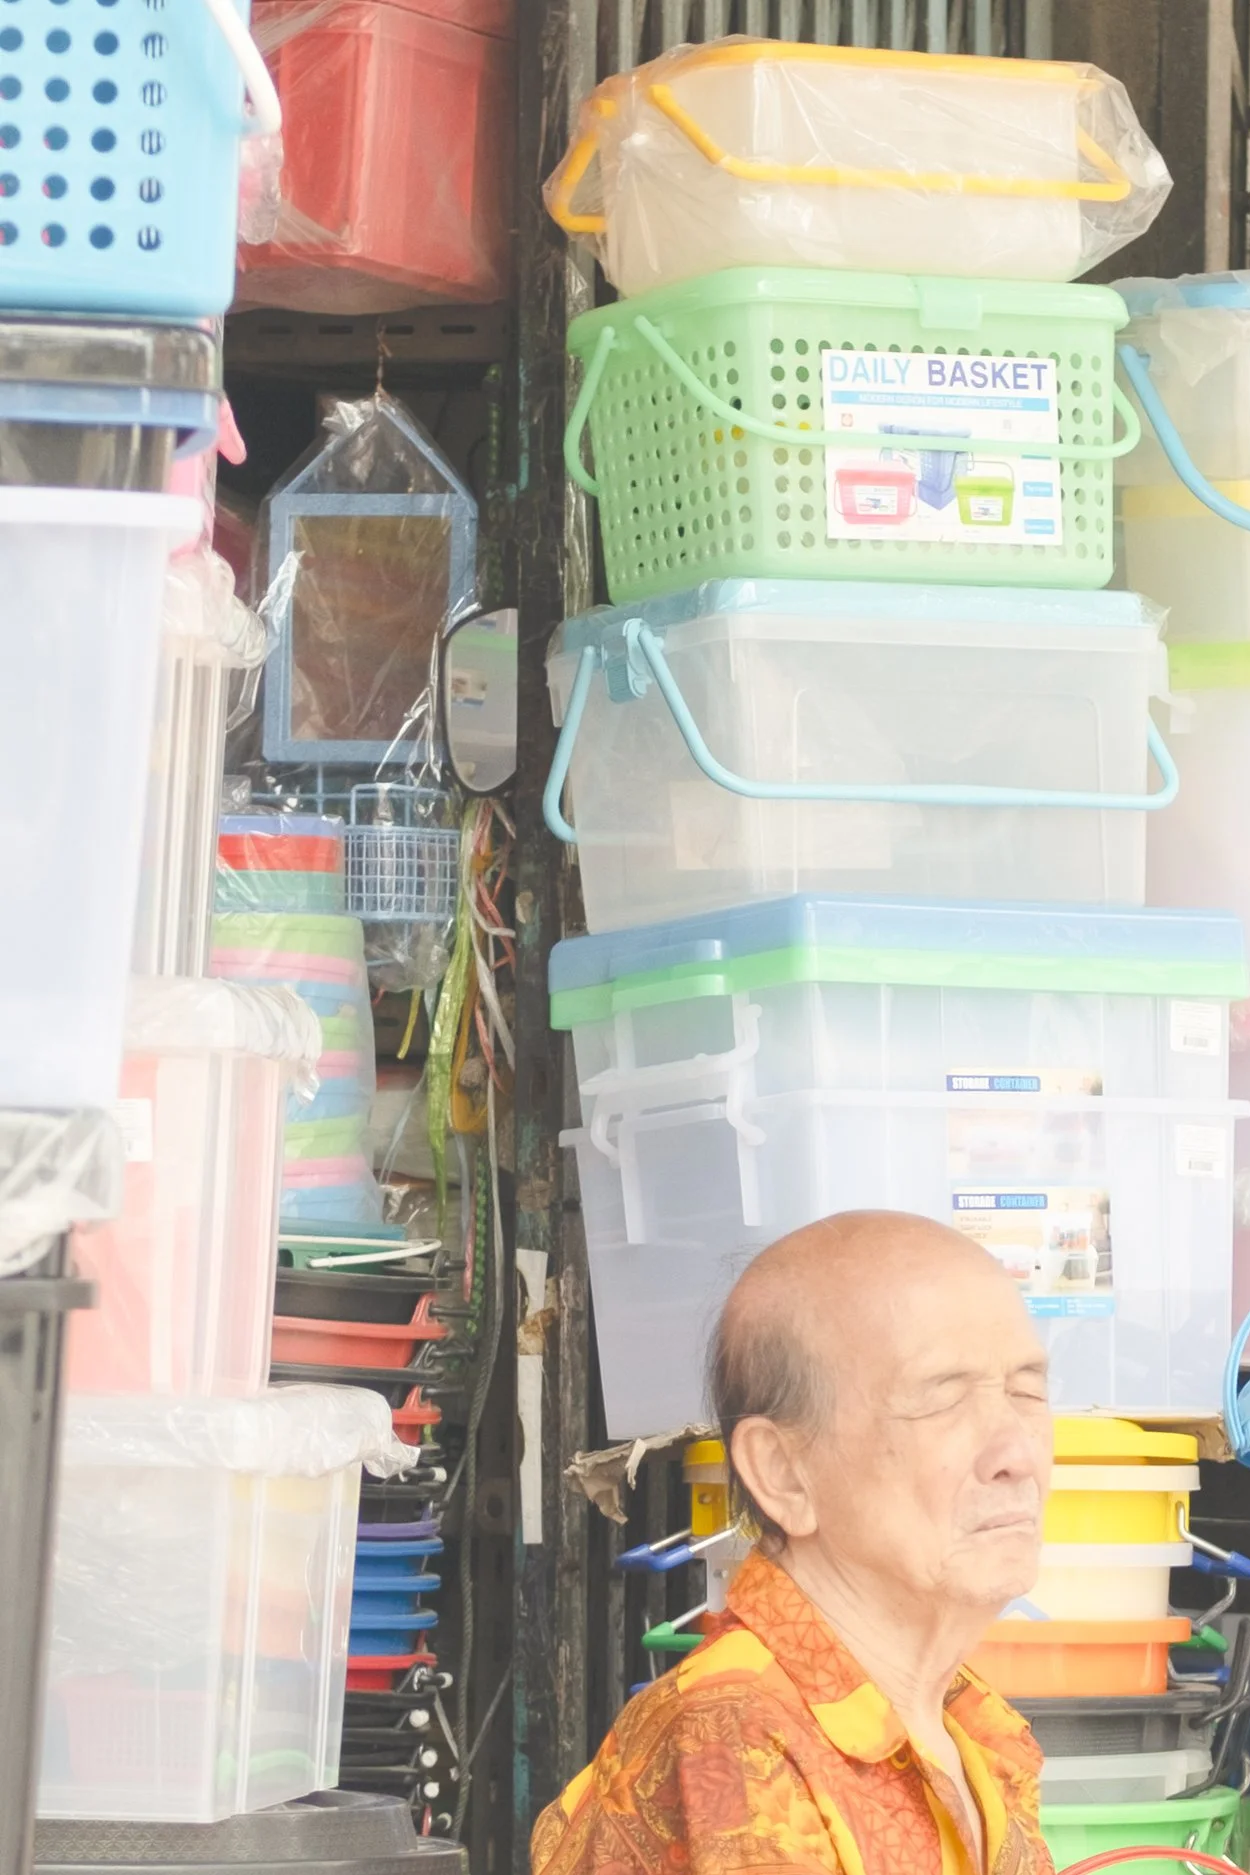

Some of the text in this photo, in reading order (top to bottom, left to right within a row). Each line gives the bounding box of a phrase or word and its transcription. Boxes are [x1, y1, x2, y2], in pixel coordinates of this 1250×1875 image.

[829, 355, 1049, 391] DAILY BASKET
[952, 1077, 1039, 1090] STORAGE CONTAINER
[958, 1195, 1045, 1209] STORAGE CONTAINER
